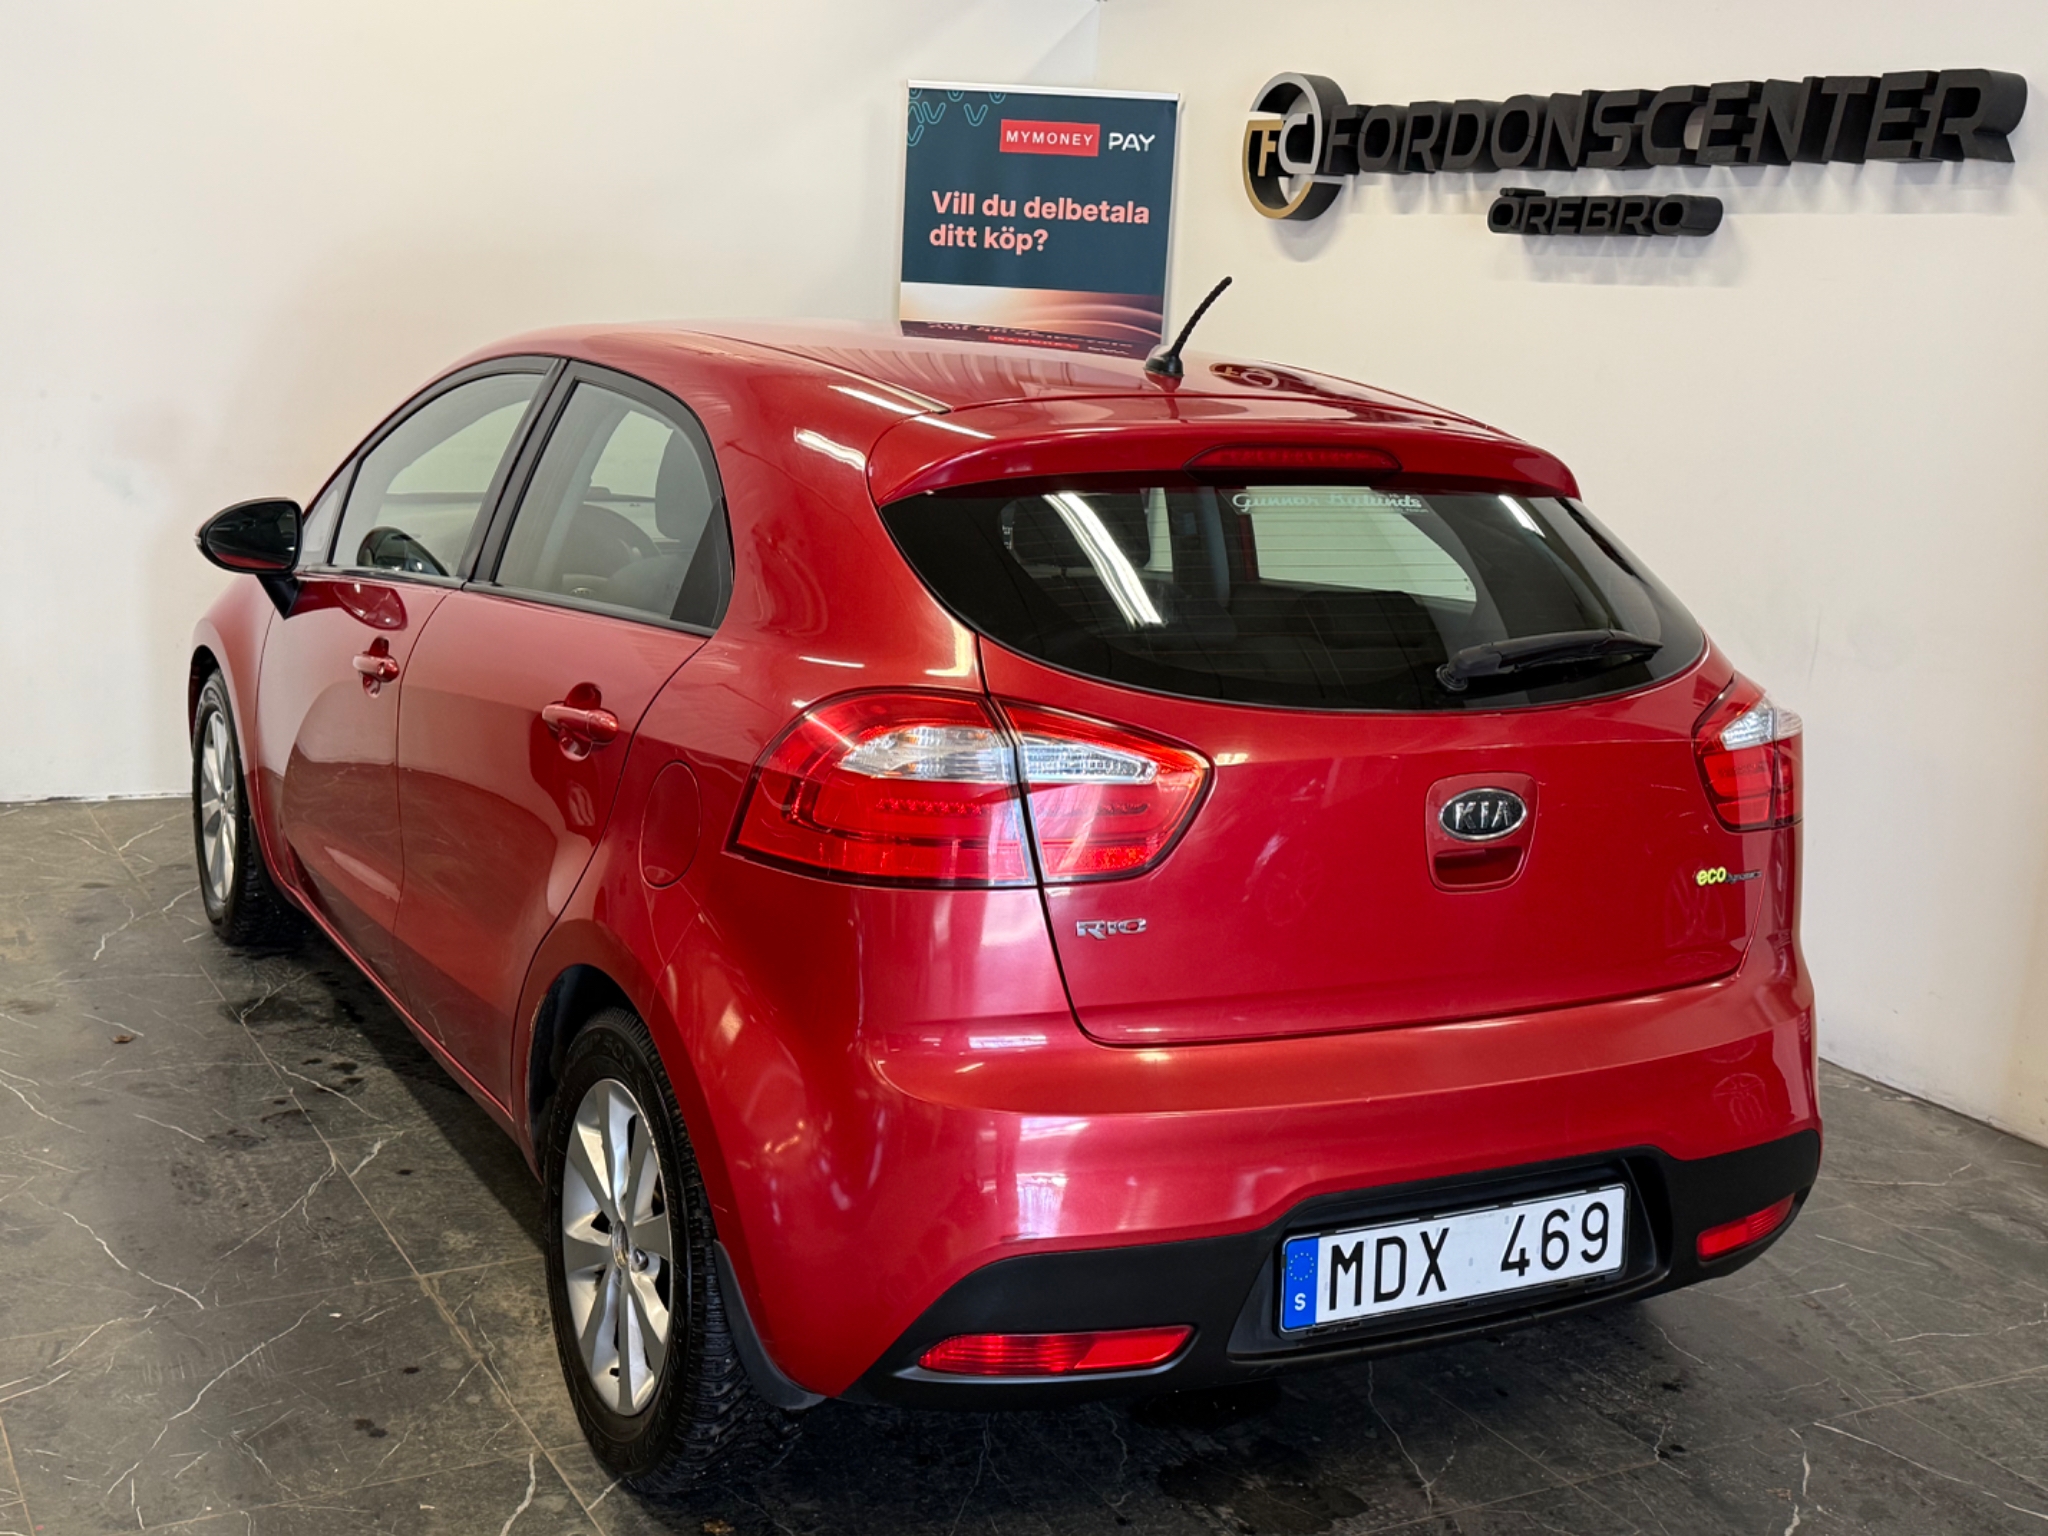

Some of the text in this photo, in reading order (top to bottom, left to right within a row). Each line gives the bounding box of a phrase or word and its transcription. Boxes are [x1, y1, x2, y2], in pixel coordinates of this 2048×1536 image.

[1323, 68, 2027, 174] FORDONSCENTER
[1005, 130, 1156, 152] MYMONEY PAY
[931, 190, 1150, 224] Vill du delbetala
[1487, 187, 1722, 237] ÖREBRO
[929, 223, 1049, 255] ditt köp?
[1455, 800, 1511, 830] KIA
[1076, 918, 1147, 940] RIO
[1328, 1201, 1610, 1311] MDX 469
[1293, 1292, 1307, 1311] S
